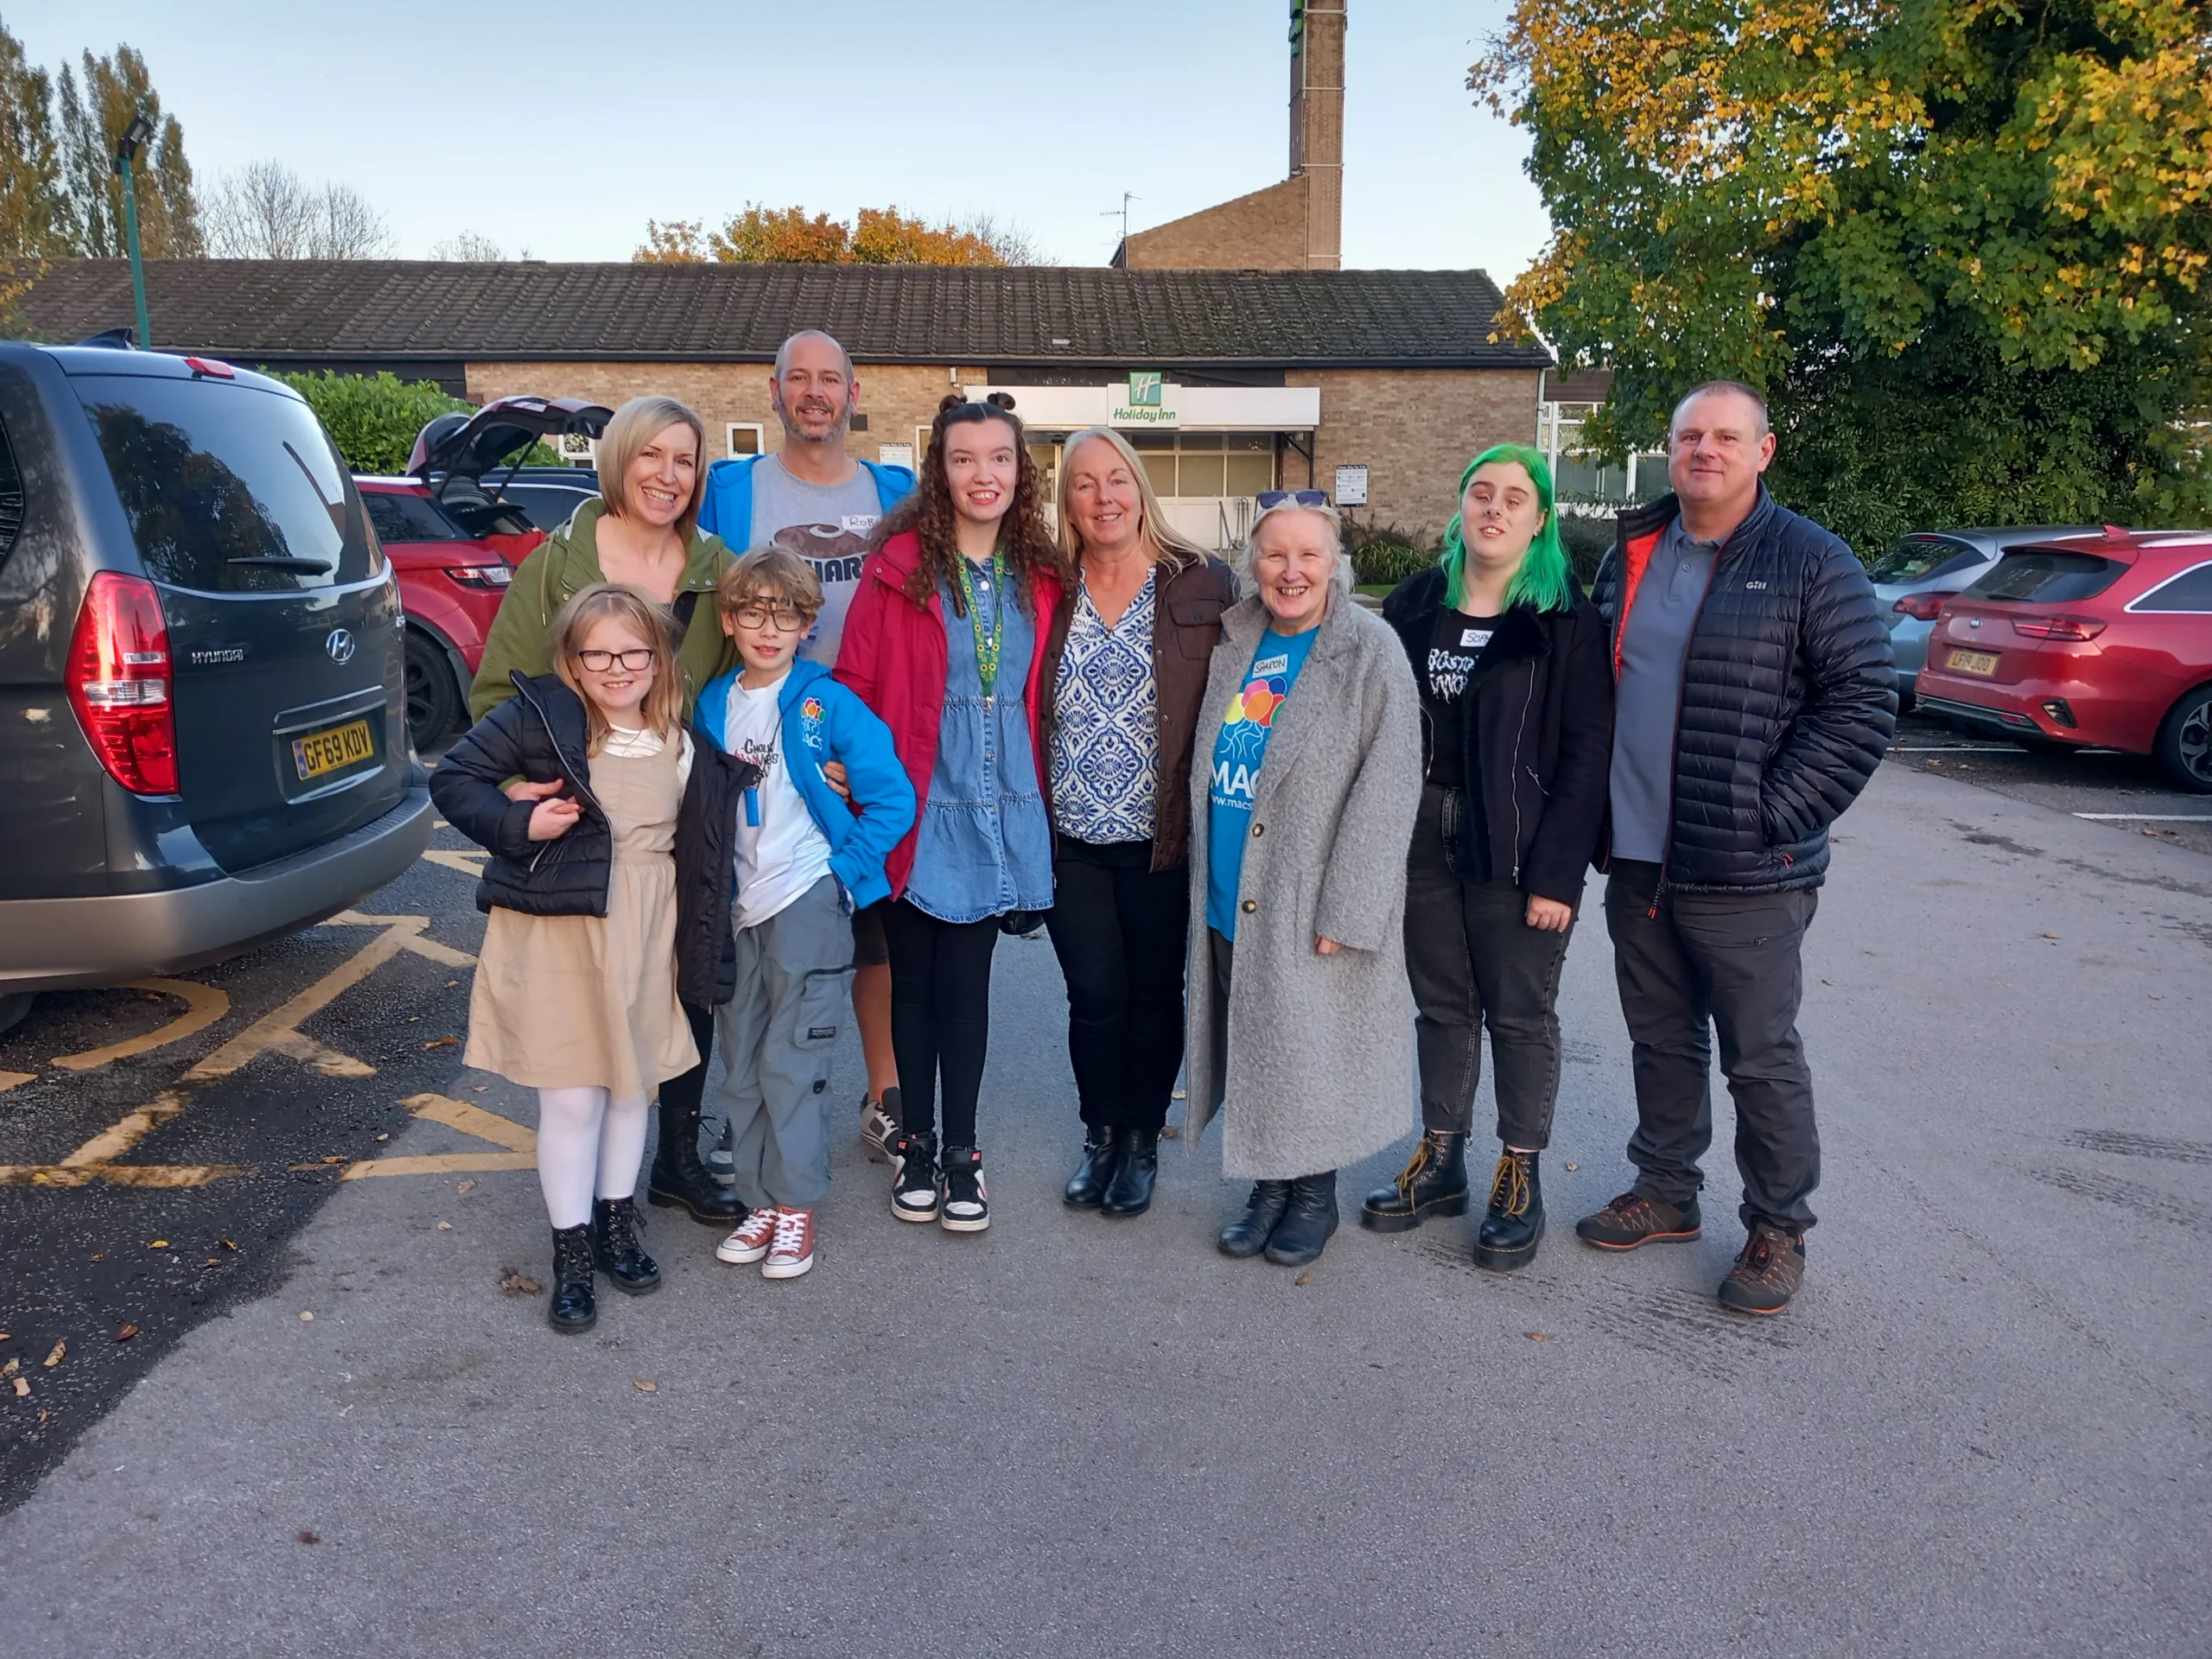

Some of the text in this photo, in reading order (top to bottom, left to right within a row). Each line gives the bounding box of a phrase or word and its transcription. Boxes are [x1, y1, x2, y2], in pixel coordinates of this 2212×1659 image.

[1113, 407, 1176, 423] Holiday Inn
[192, 649, 244, 664] HYUNDAI
[1254, 658, 1286, 674] SHARON
[304, 734, 343, 771] GF69
[342, 726, 368, 759] KDV
